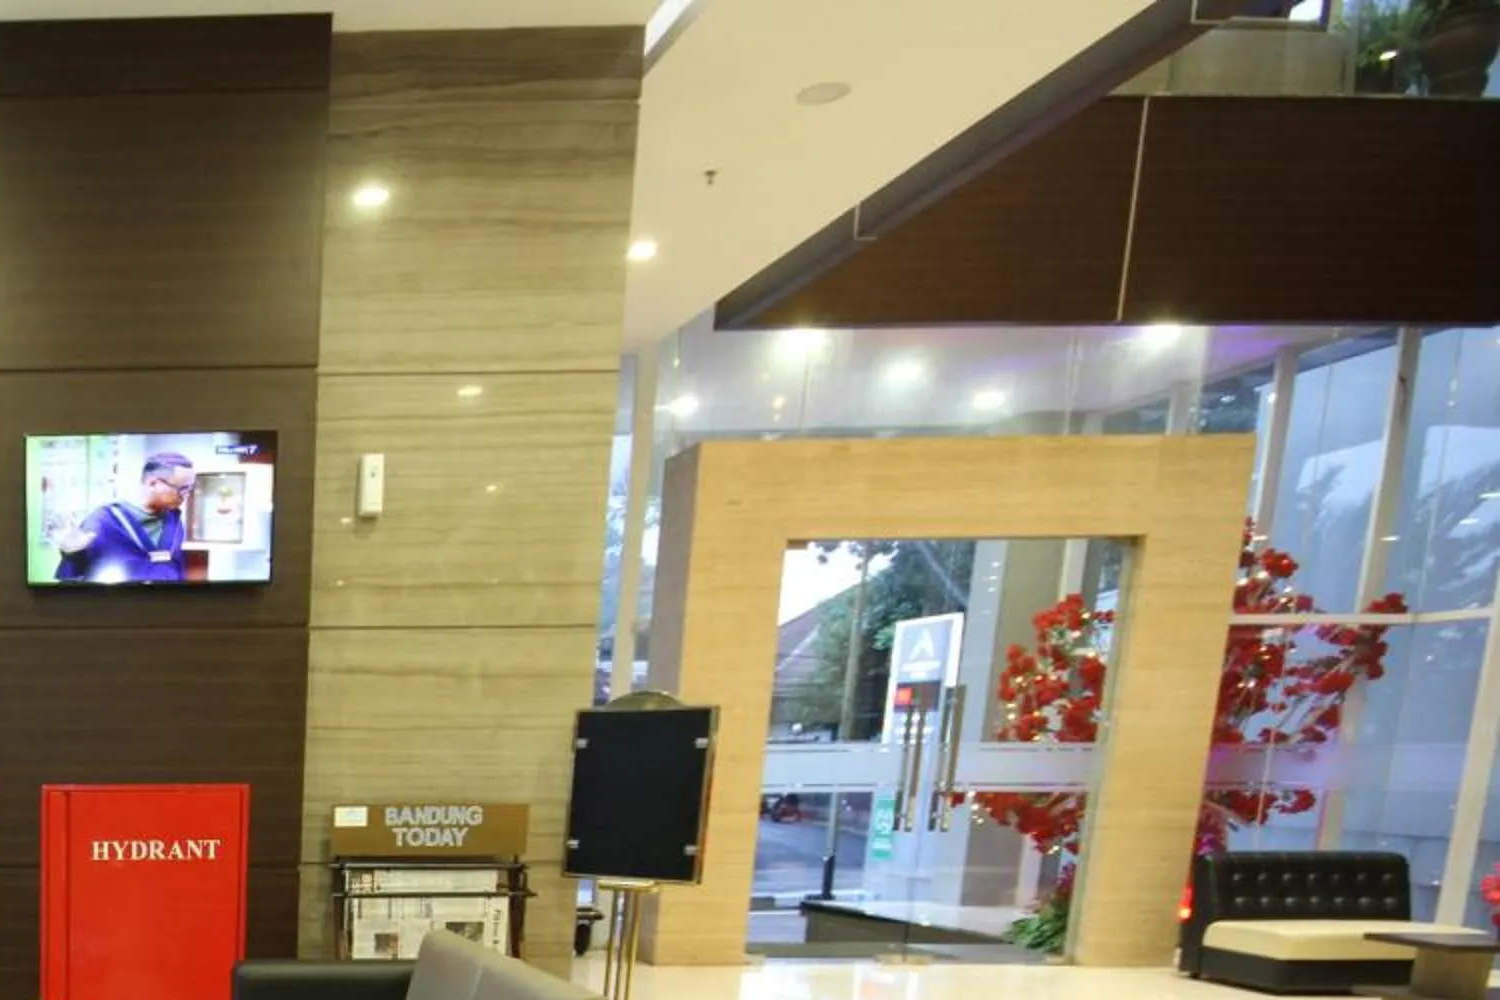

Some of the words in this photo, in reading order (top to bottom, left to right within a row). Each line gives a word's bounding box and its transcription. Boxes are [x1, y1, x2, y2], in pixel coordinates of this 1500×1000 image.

[384, 805, 484, 826] BANDUNG
[392, 827, 469, 848] TODAY
[91, 838, 221, 861] HYDRANT
